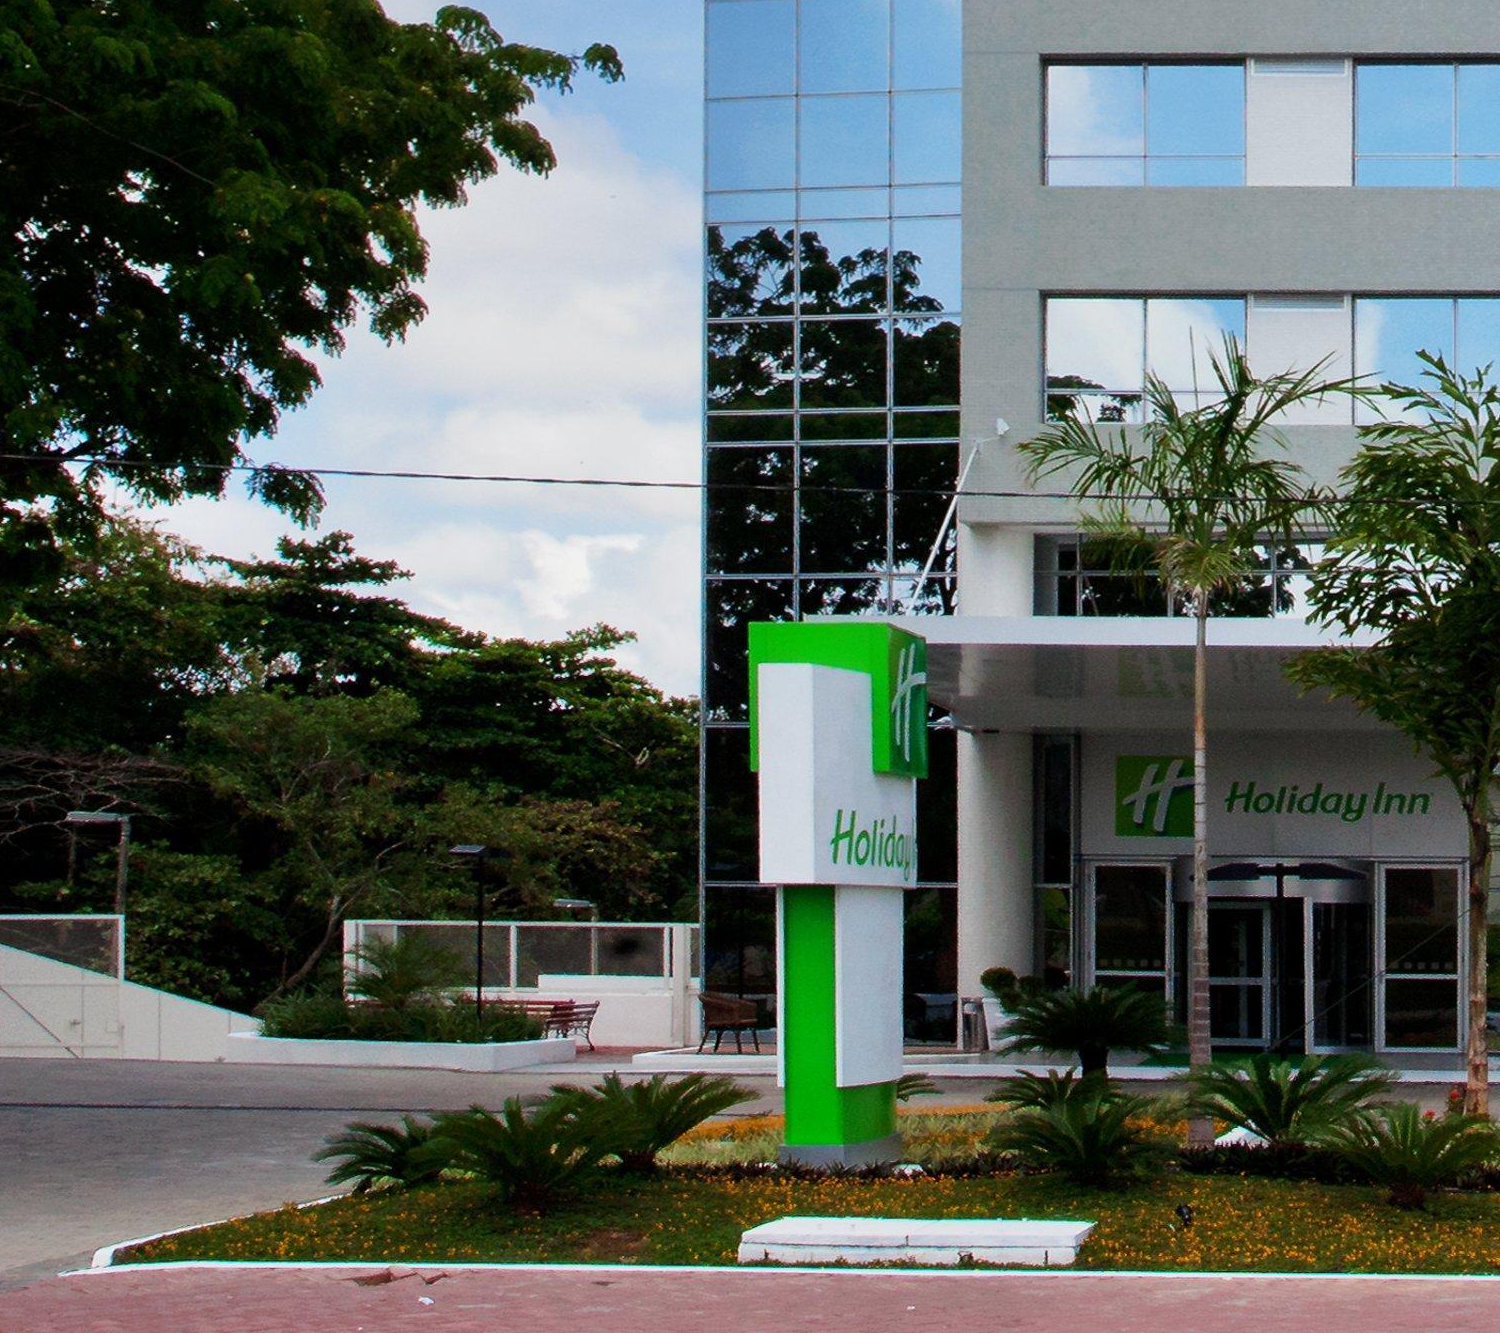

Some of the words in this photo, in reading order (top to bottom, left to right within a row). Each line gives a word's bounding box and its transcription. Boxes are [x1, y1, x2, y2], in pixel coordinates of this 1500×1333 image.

[1224, 781, 1368, 823] Holiday
[1372, 782, 1431, 815] Inn
[830, 808, 911, 882] Holiday
